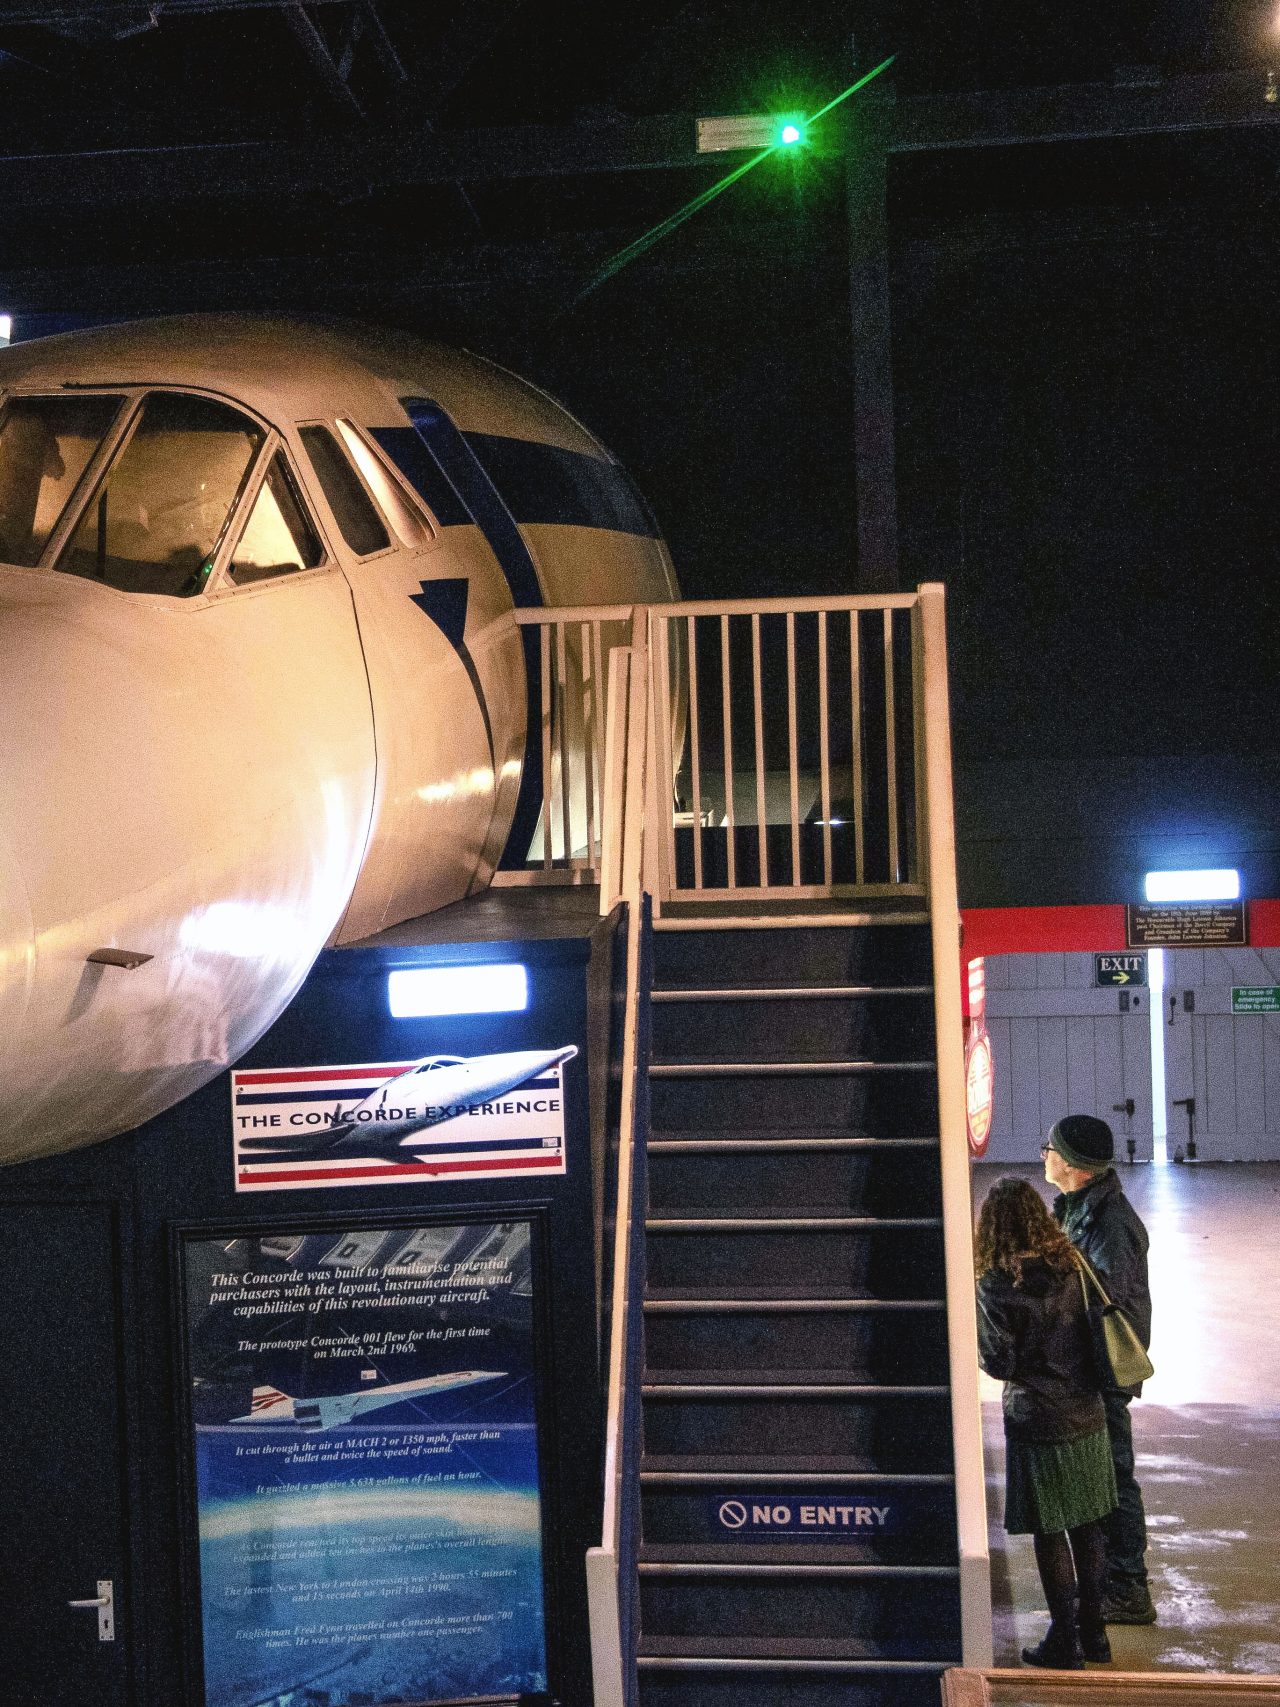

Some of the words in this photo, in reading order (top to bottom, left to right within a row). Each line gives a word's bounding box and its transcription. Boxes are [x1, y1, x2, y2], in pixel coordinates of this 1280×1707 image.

[1100, 956, 1141, 971] EXIT
[237, 1114, 282, 1128] THE
[288, 1106, 417, 1126] CONCORDE
[425, 1099, 561, 1119] EXPERIENCE
[210, 1274, 239, 1285] This
[241, 1270, 304, 1283] Concorde
[306, 1271, 331, 1279] was
[334, 1265, 366, 1278] built
[365, 1265, 380, 1276] to
[380, 1263, 451, 1278] familiarise
[453, 1257, 510, 1274] potential
[209, 1288, 281, 1303] purchasers
[283, 1284, 312, 1296] with
[314, 1283, 336, 1294] the
[338, 1280, 382, 1295] layout,
[384, 1275, 484, 1290] instrumentation
[487, 1272, 512, 1284] and
[232, 1301, 305, 1317] capabilities
[307, 1299, 324, 1313] of
[324, 1298, 349, 1310] this
[350, 1295, 437, 1308] revolutionary
[438, 1289, 490, 1304] aircraft.
[237, 1340, 258, 1350] The
[259, 1337, 309, 1351] prototype
[310, 1334, 361, 1346] Concorde
[362, 1332, 381, 1343] 001
[382, 1332, 406, 1344] flew
[407, 1331, 424, 1343] for
[425, 1329, 443, 1339] the
[443, 1328, 466, 1341] first
[468, 1327, 491, 1337] time
[329, 1345, 364, 1357] March
[366, 1344, 387, 1355] 2nd
[389, 1343, 417, 1353] 1969.
[235, 1444, 244, 1454] It
[245, 1443, 261, 1454] cut
[262, 1441, 300, 1453] through
[301, 1440, 317, 1450] the
[319, 1441, 333, 1449] air
[334, 1438, 344, 1448] at
[346, 1436, 379, 1447] MACH
[380, 1435, 388, 1445] 2
[402, 1433, 425, 1444] 1350
[425, 1432, 450, 1445] mph,
[451, 1430, 478, 1444] faster
[479, 1429, 500, 1439] than
[292, 1451, 320, 1462] bullet
[320, 1450, 339, 1461] and
[340, 1450, 363, 1459] twice
[364, 1448, 381, 1458] the
[382, 1446, 409, 1459] speed
[410, 1445, 424, 1457] of
[423, 1443, 453, 1454] sound.
[752, 1506, 791, 1525] NO
[800, 1506, 890, 1525] ENTRY
